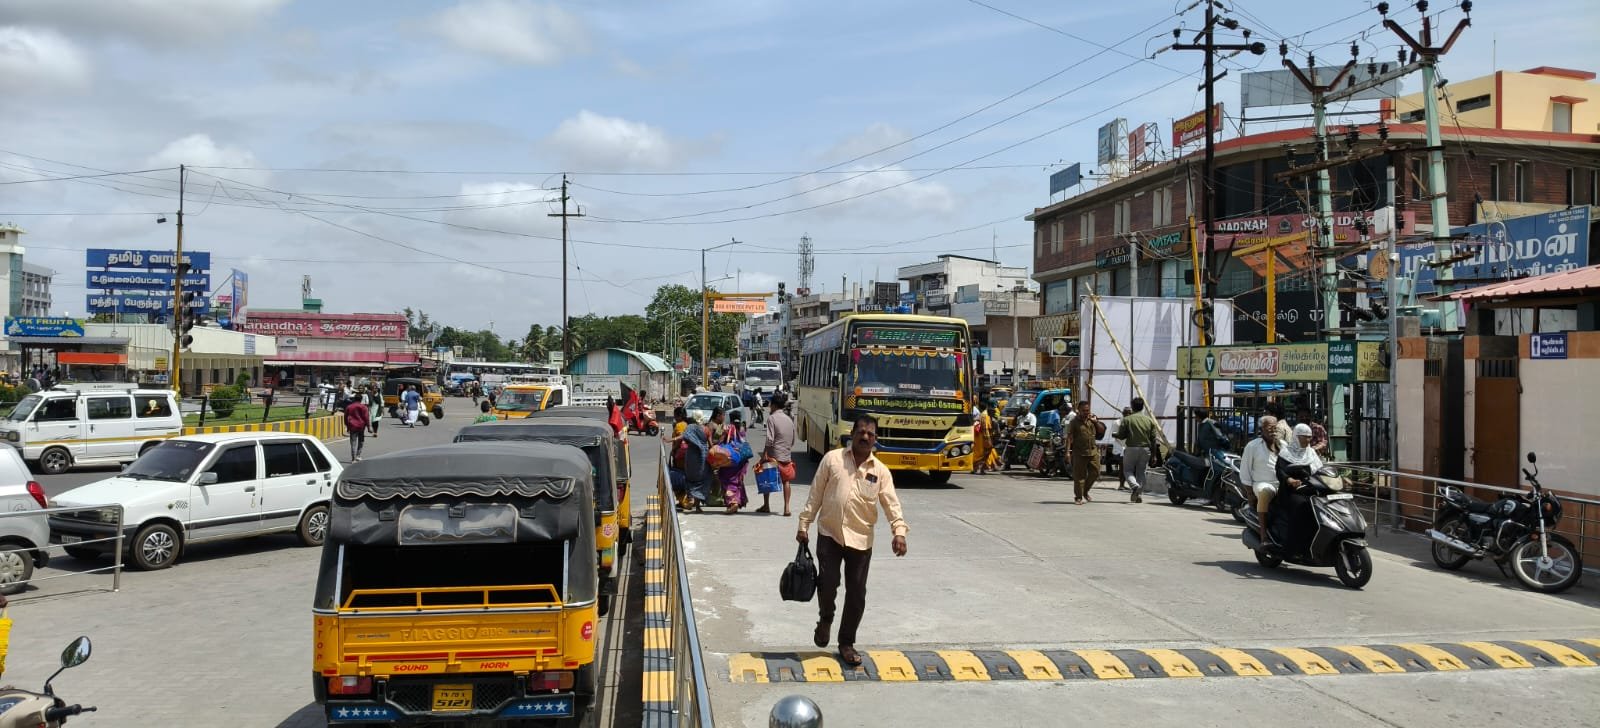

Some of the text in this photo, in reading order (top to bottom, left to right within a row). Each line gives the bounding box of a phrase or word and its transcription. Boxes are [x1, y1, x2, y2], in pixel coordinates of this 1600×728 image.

[1147, 231, 1181, 249] AVATAR
[108, 250, 143, 266] தமிழ்
[1111, 253, 1131, 265] FASHIO
[1221, 351, 1277, 372] வேலவன்
[393, 661, 510, 672] SOUND HORN
[435, 699, 470, 707] 5121
